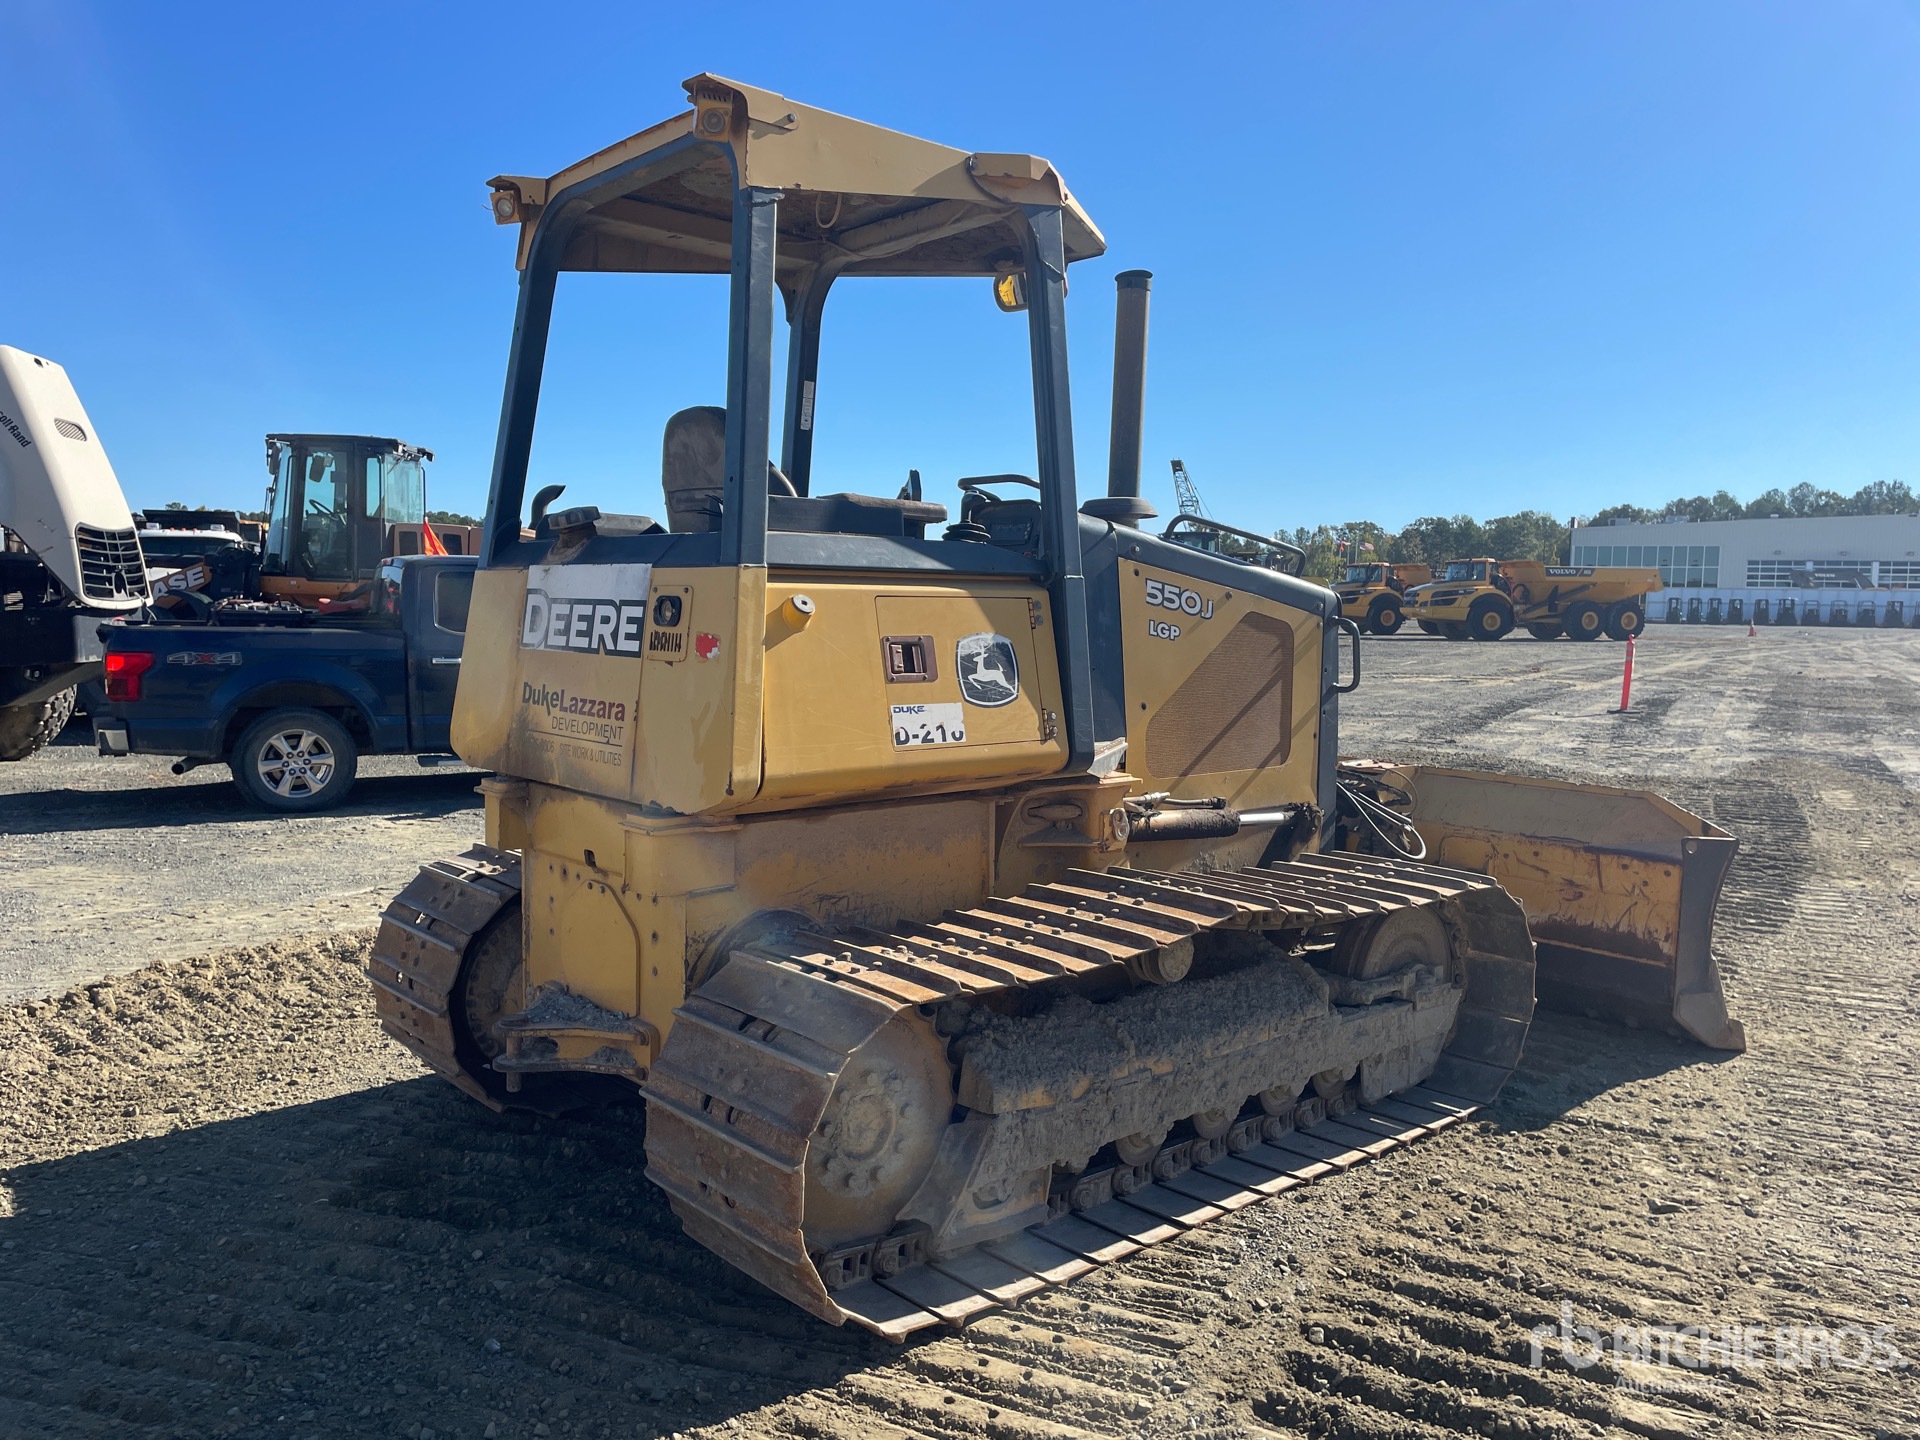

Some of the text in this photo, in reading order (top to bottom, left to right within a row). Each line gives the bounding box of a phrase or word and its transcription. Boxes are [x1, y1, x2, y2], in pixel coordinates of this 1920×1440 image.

[8, 424, 32, 448] Rand
[153, 566, 205, 600] ASE
[521, 590, 645, 655] DEERE
[1149, 619, 1181, 640] LGP
[893, 705, 925, 715] DUKE
[551, 716, 624, 740] DEVELOPMENT
